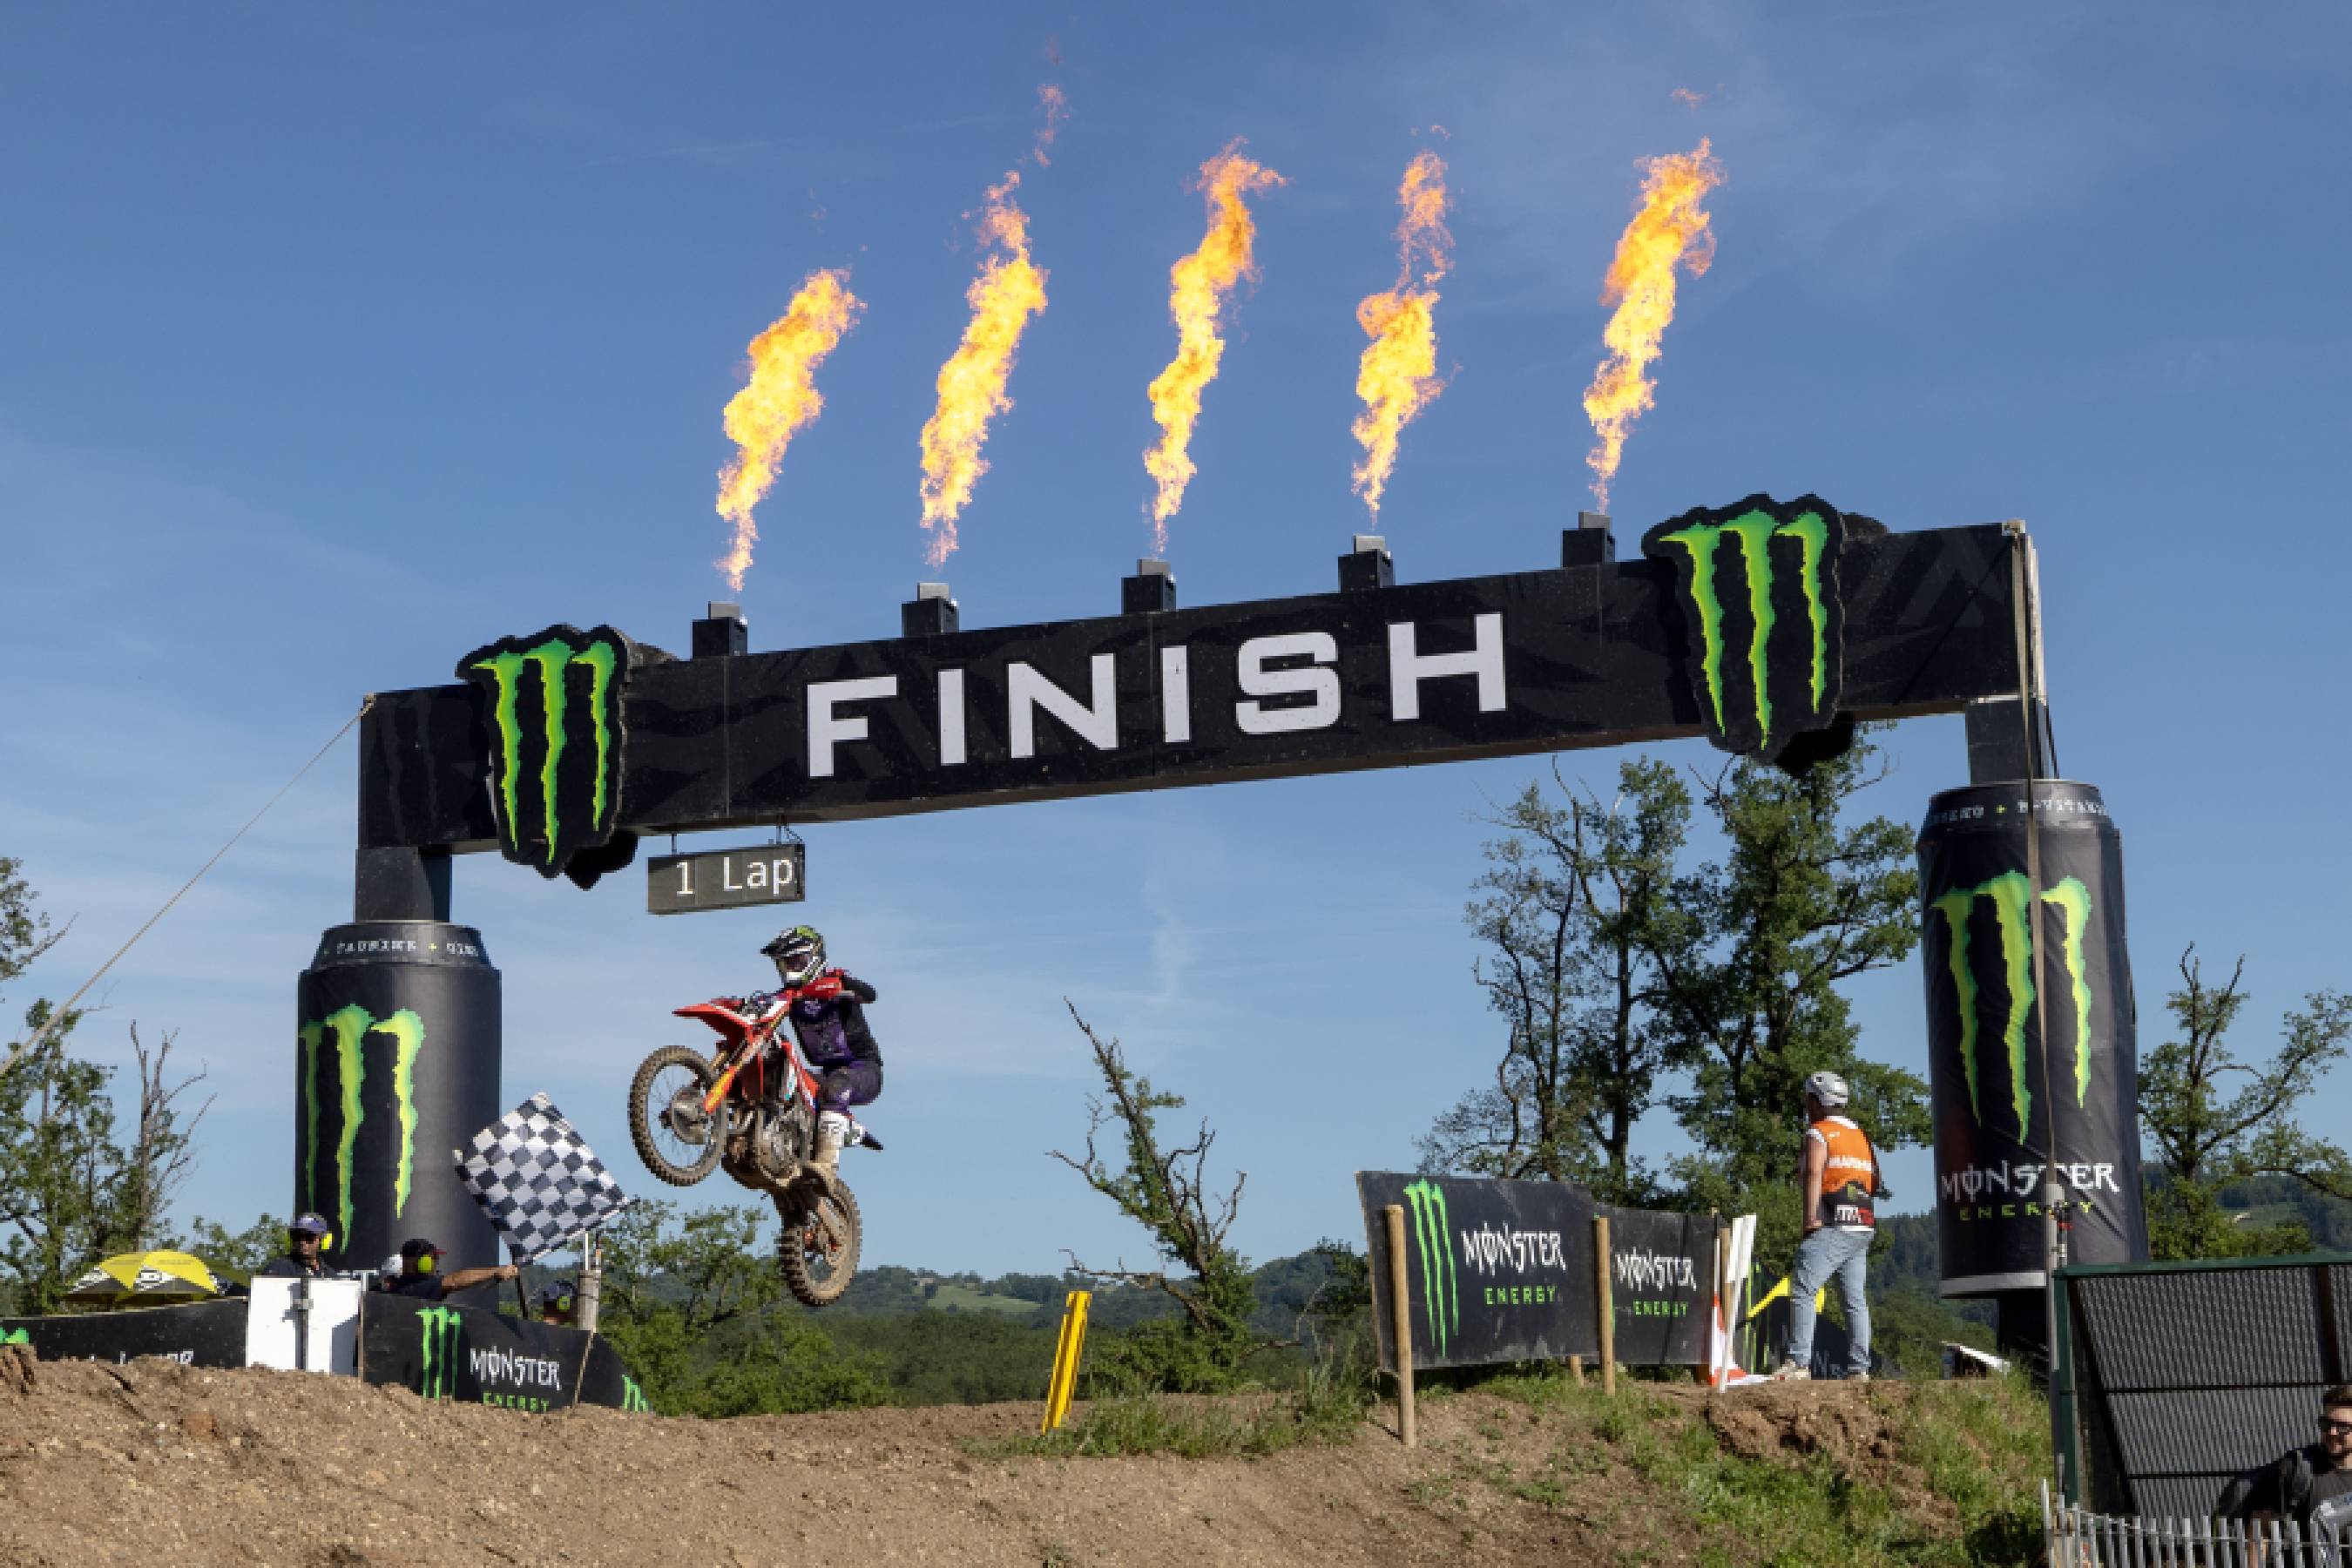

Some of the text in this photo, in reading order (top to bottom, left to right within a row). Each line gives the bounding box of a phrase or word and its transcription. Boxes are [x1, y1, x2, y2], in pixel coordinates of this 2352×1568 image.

[807, 612, 1509, 779] FINISH
[676, 856, 794, 896] 1 Lap
[1959, 1200, 2092, 1221] ENERY
[1461, 1220, 1567, 1277] MONSTER
[1616, 1246, 1698, 1293] MONSTER
[1484, 1285, 1558, 1306] ENERGY
[1632, 1301, 1689, 1318] ENERGY
[470, 1345, 563, 1392] MONSTER
